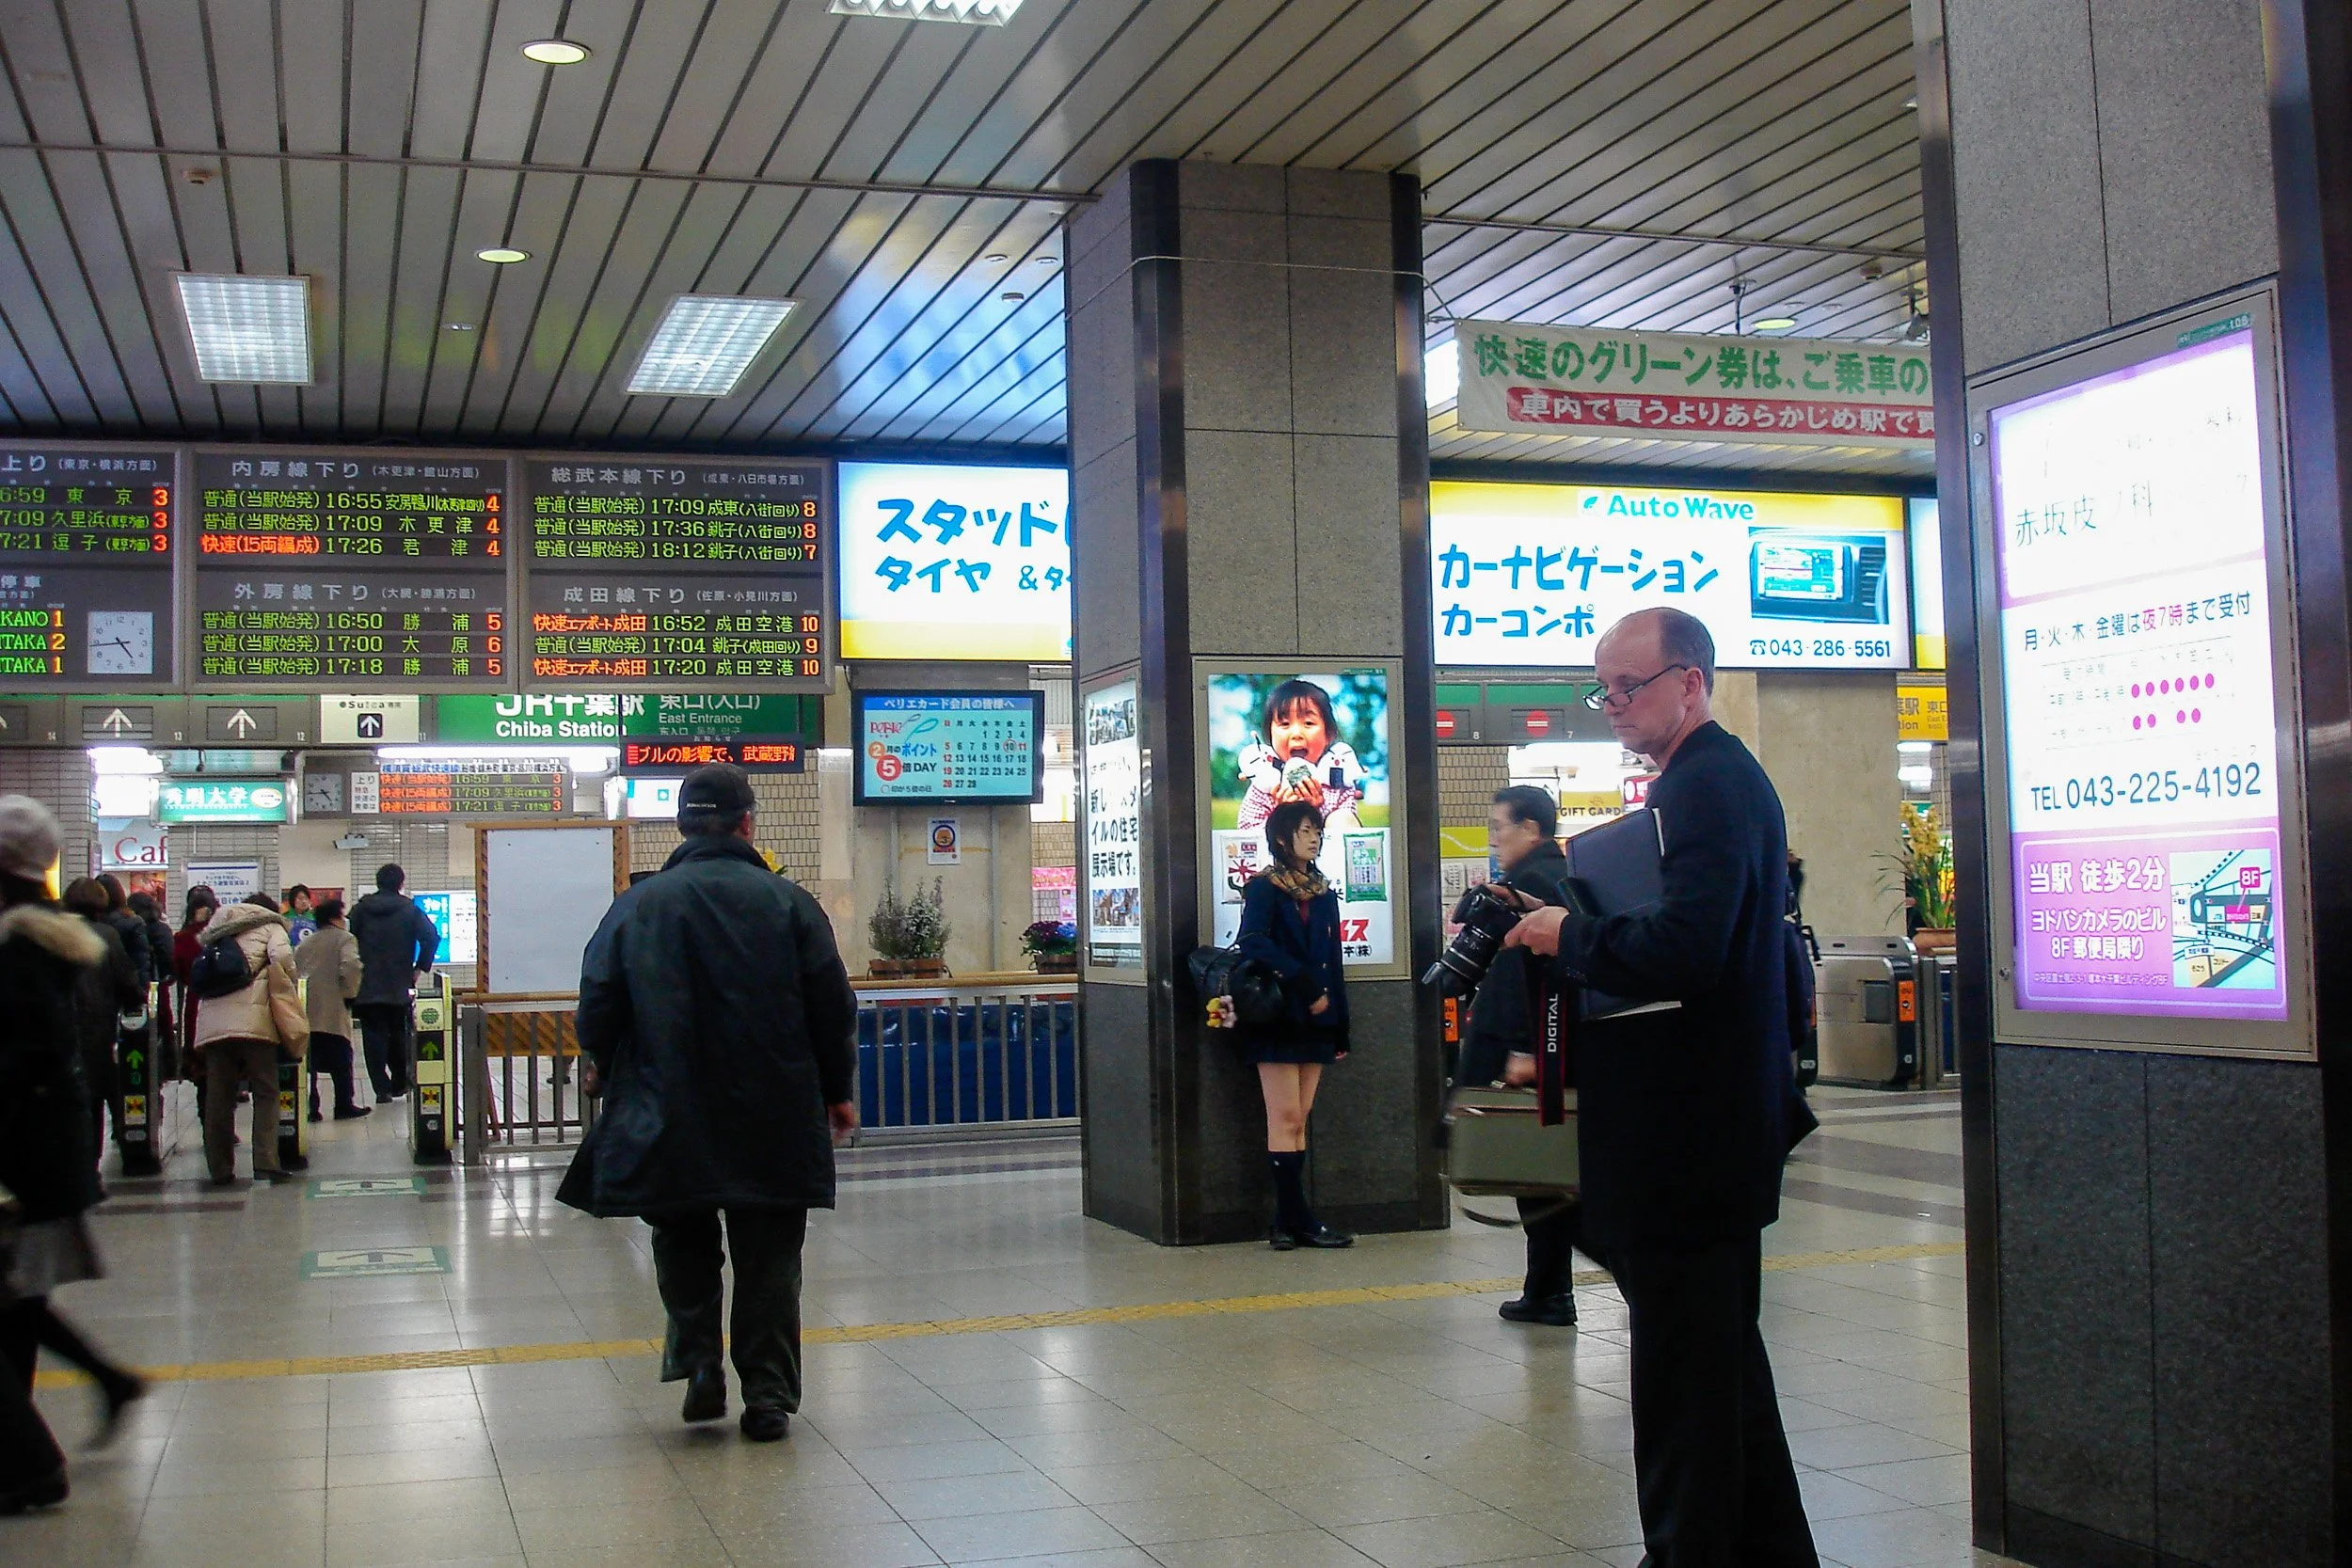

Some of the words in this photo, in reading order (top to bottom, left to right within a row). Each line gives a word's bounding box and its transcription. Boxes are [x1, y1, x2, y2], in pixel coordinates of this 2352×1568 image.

[1, 455, 46, 471] 上り
[232, 460, 358, 479] 内房線下り
[551, 467, 685, 485] 総武本線下り
[67, 488, 133, 506] 東京
[152, 488, 169, 506] 3
[203, 490, 320, 509] 普通(当駅始発)
[326, 492, 382, 510] 16:55
[486, 495, 501, 513] 4
[533, 495, 645, 515] 普通(当駅始発)
[651, 499, 705, 515] 17:09
[707, 499, 800, 517] 成東(八街回り)
[803, 501, 817, 517] 8
[1607, 495, 1678, 518] Auto
[1685, 497, 1754, 520] Wave
[152, 512, 169, 529] 3
[203, 513, 320, 531] 普通(当駅始発)
[326, 515, 383, 532] 17:09
[399, 515, 473, 534] 木更津
[486, 517, 501, 534] 4
[533, 517, 645, 536] 普通(当駅始発)
[651, 520, 705, 536] 17:36
[707, 520, 802, 540] 銚子(八街回り)
[803, 523, 817, 539] 8
[152, 534, 169, 551] 3
[200, 534, 320, 554] 快速(15両編成)
[326, 537, 383, 554] 17:26
[403, 538, 469, 557] 君津
[486, 540, 501, 557] 4
[533, 539, 645, 558] 普通(当駅始発)
[651, 542, 705, 559] 18:12
[707, 542, 803, 561] 銚子(八街回り)
[803, 544, 817, 561] 7
[875, 555, 992, 594] タイヤ
[1438, 542, 1719, 594] カーナビゲーション
[235, 582, 368, 601] 外房線下り
[564, 586, 685, 604] 成田線下り
[54, 610, 64, 627] 1
[203, 612, 320, 629] 普通(当駅始発)
[326, 612, 383, 630] 16:50
[403, 613, 469, 631] 勝浦
[487, 613, 501, 631] 5
[532, 613, 646, 632] 快速エアポート成田
[652, 615, 706, 631] 16:52
[715, 615, 794, 632] 成田空港
[802, 616, 818, 632] 10
[52, 633, 66, 650] 2
[203, 634, 320, 653] 普通(当駅始発)
[326, 635, 383, 653] 17:00
[402, 635, 469, 654] 大原
[487, 636, 501, 654] 6
[534, 636, 646, 654] 普通(当駅始発)
[652, 637, 706, 654] 17:04
[712, 637, 801, 655] 銚子(成田回り)
[805, 638, 818, 654] 9
[54, 656, 64, 673] 1
[203, 657, 320, 675] 普通(当駅始発)
[326, 657, 383, 674] 17:18
[403, 657, 469, 675] 勝浦
[487, 658, 501, 676] 5
[532, 657, 647, 676] 快速エアポート成田
[652, 658, 707, 675] 17:20
[715, 658, 794, 676] 成田空港
[803, 658, 819, 675] 10
[660, 712, 686, 724] East
[690, 712, 743, 724] Entrance
[496, 721, 553, 737] Chiba
[558, 721, 628, 737] Station
[982, 730, 987, 738] 1
[995, 730, 1000, 738] 2
[1008, 730, 1012, 738] 3
[1020, 730, 1025, 738] 4
[945, 742, 950, 751] 5
[969, 742, 975, 751] 7
[956, 754, 964, 763] 13
[968, 754, 977, 763] 14
[980, 754, 989, 763] 15
[1005, 754, 1014, 763] 17
[455, 774, 490, 784] 16:59
[552, 773, 562, 784] 3
[967, 767, 977, 776] 21
[980, 767, 989, 776] 22
[993, 767, 1001, 776] 23
[1005, 767, 1013, 776] 24
[1017, 767, 1026, 776] 25
[455, 786, 490, 798] 17:09
[552, 786, 562, 798] 3
[955, 780, 964, 788] 27
[2031, 786, 2061, 811] TEL
[2066, 762, 2261, 810] 043-225-4192
[455, 800, 488, 812] 17:21
[552, 800, 562, 812] 3
[1560, 807, 1585, 817] GIFT
[115, 835, 168, 863] Caf
[2029, 861, 2073, 894] 当駅
[2079, 856, 2167, 893] 徒歩2分
[2242, 870, 2260, 885] 8F
[2051, 937, 2071, 959] 8F
[1547, 993, 1559, 1053] DIGITAL
